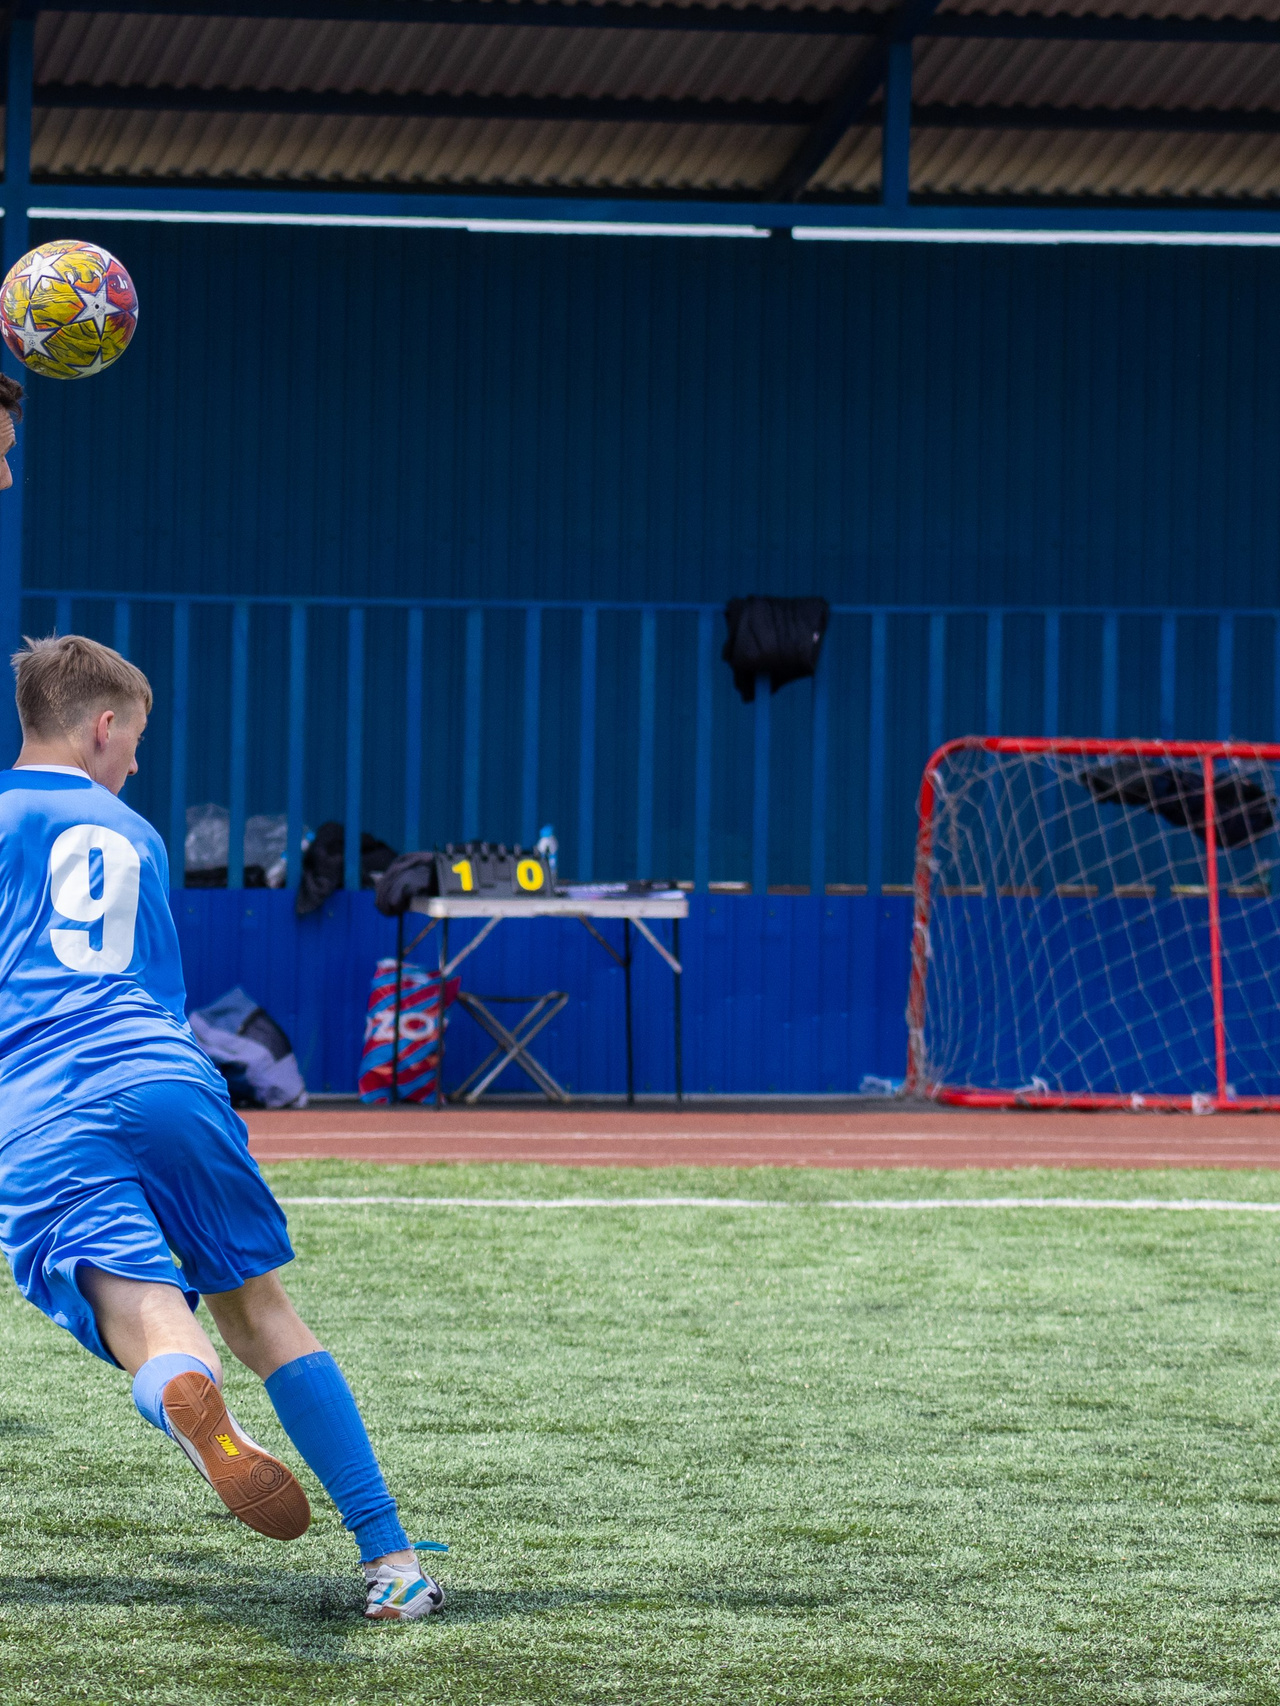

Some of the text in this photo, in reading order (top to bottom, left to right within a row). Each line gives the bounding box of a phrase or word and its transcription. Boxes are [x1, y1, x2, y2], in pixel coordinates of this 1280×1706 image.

[451, 858, 545, 892] 1 0
[50, 824, 141, 974] 9
[214, 1433, 240, 1457] NIKE
